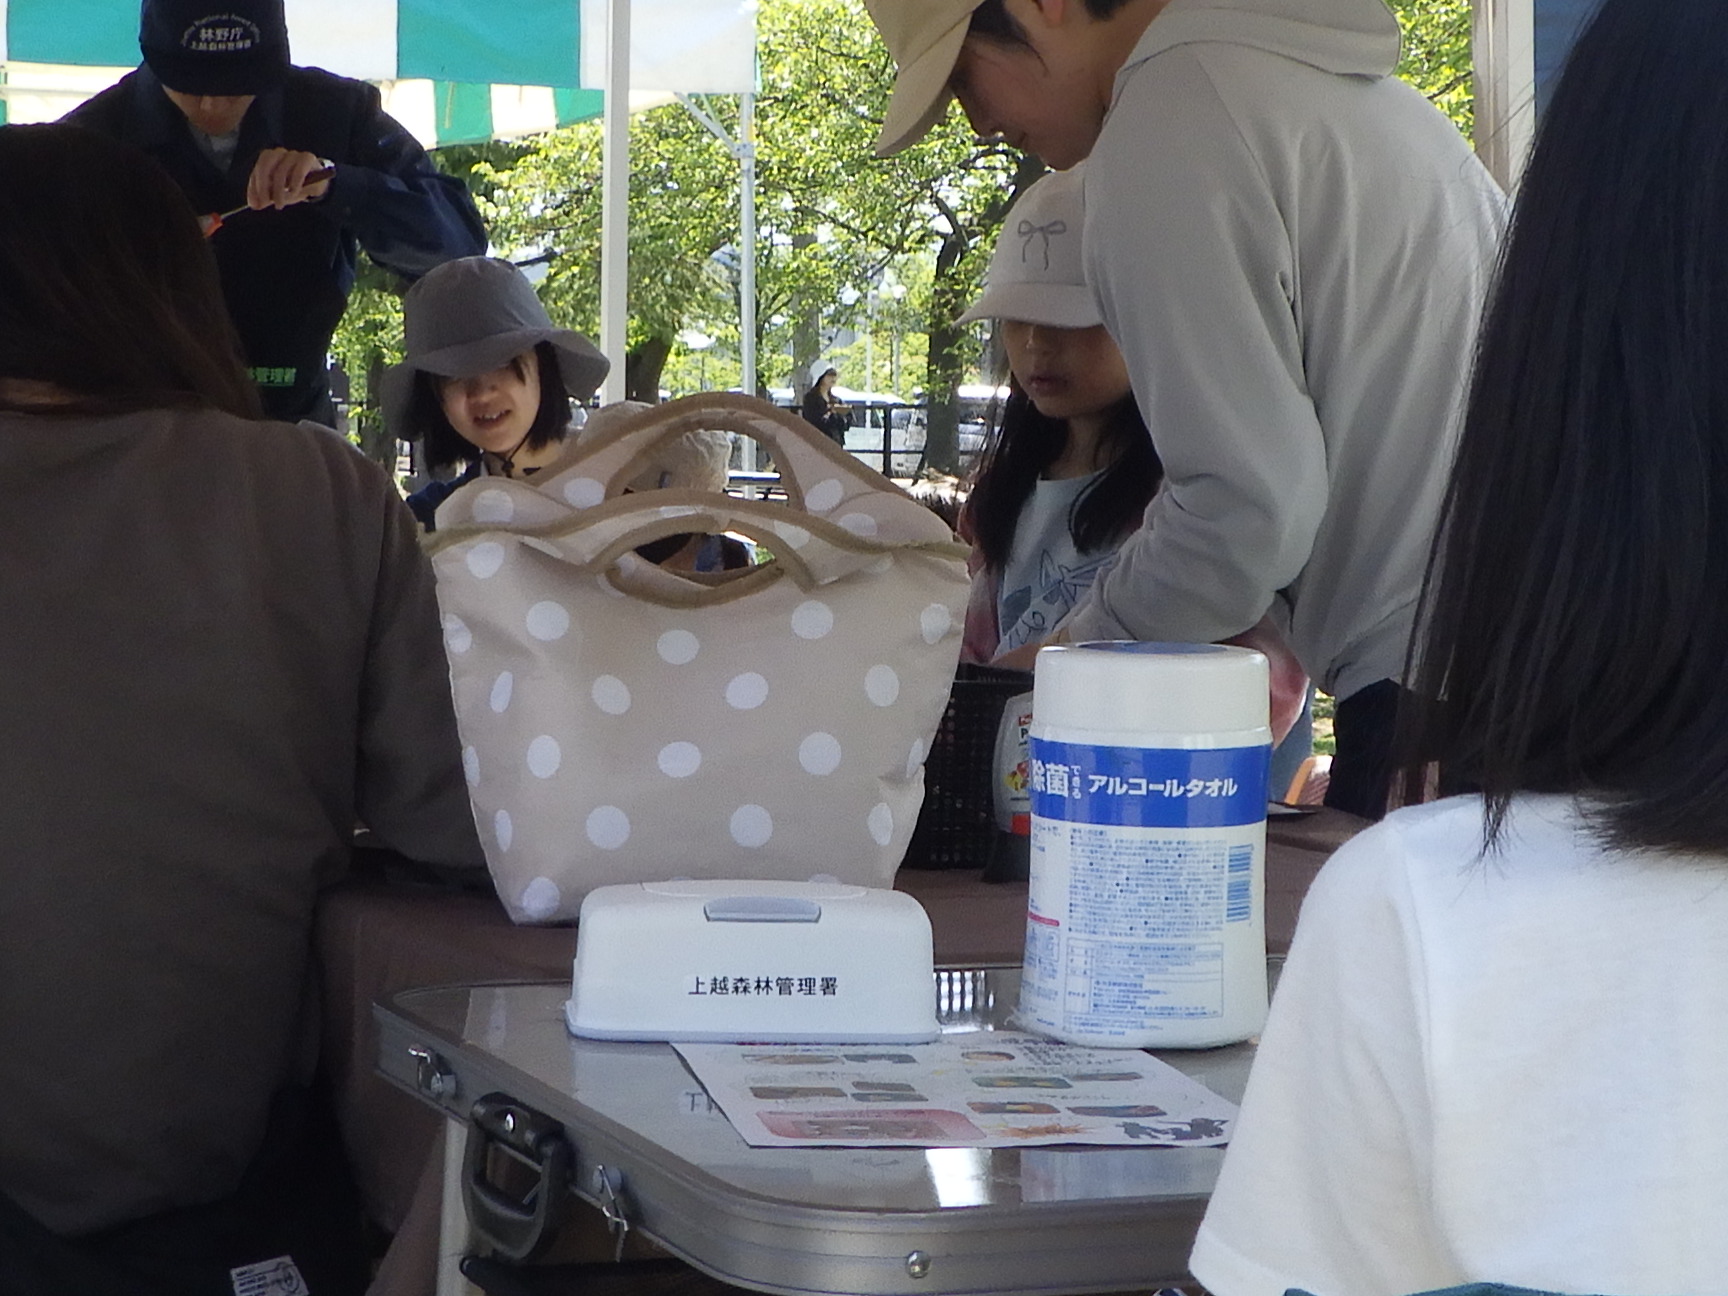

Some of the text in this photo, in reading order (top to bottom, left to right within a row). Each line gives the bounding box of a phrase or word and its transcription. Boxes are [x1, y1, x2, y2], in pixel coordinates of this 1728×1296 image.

[1088, 774, 1239, 799] アルコールタオル
[687, 975, 839, 997] 上越森林管理署
